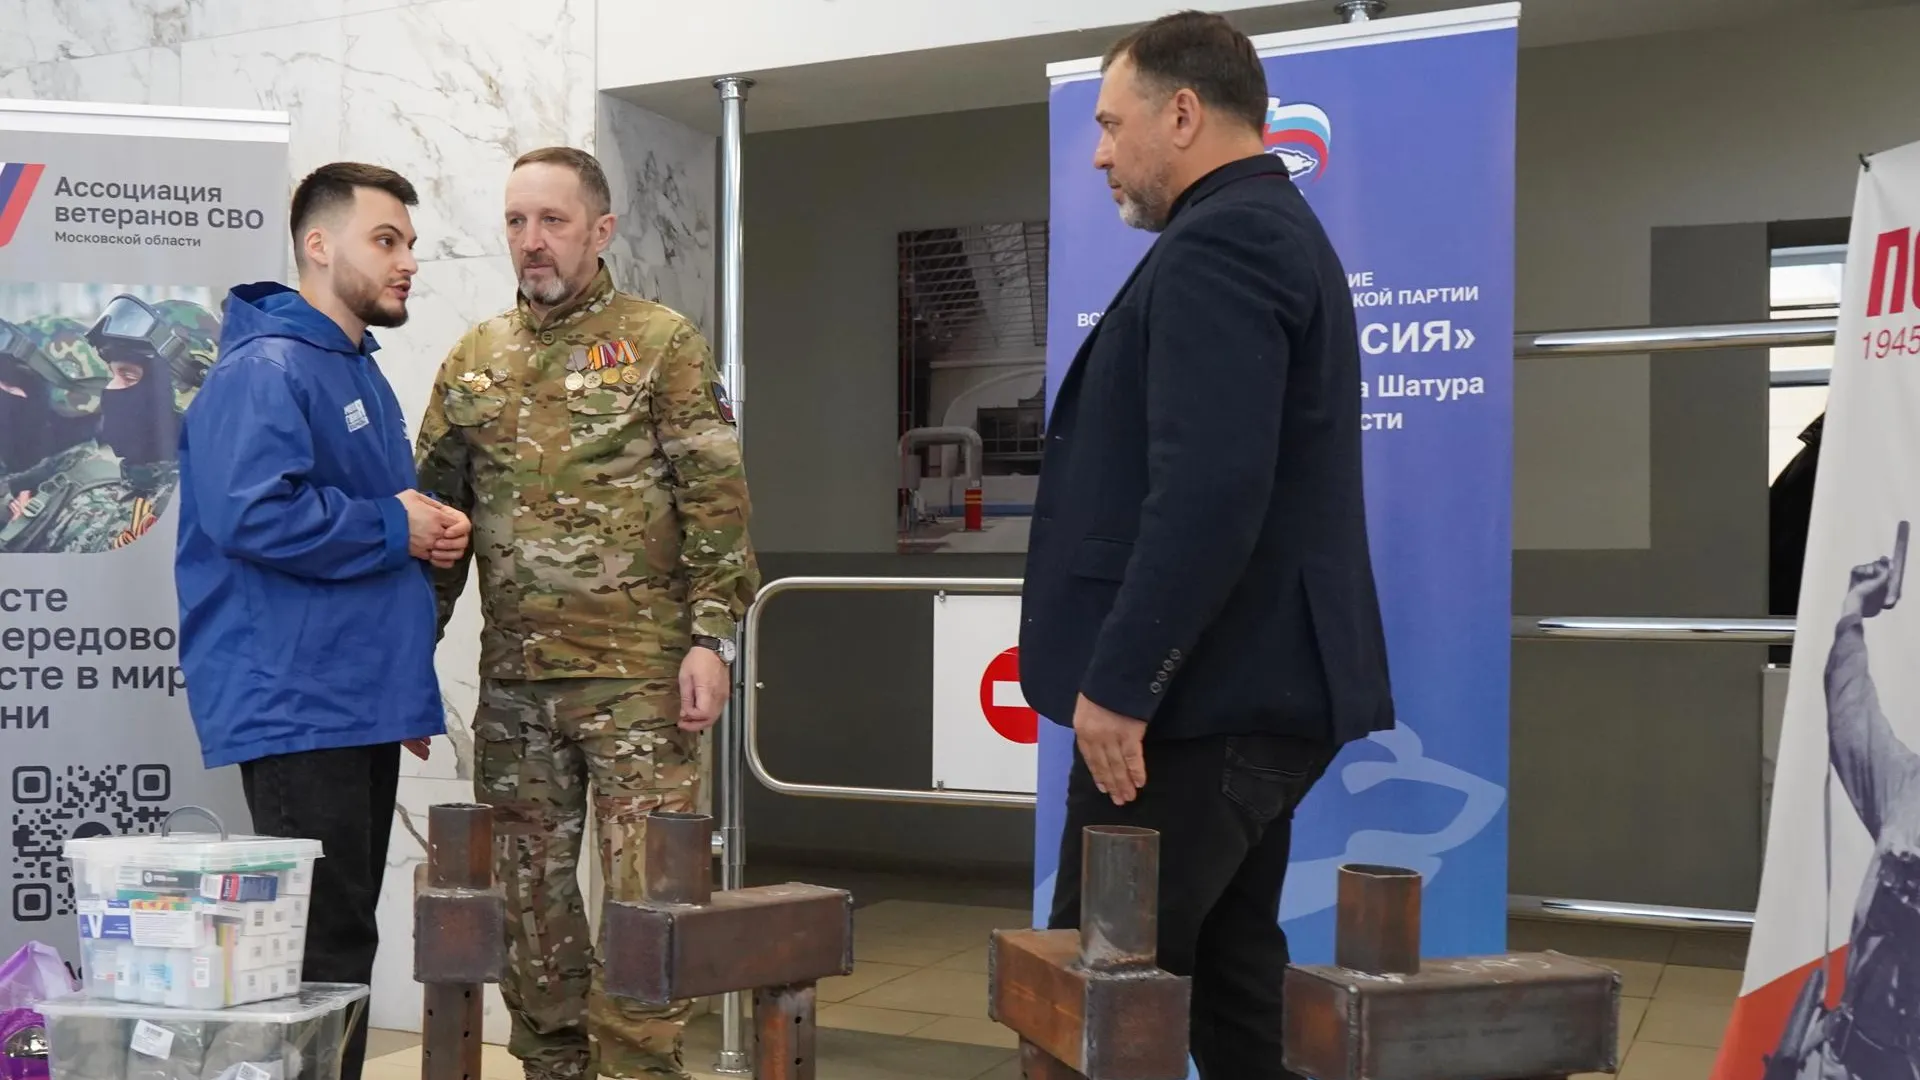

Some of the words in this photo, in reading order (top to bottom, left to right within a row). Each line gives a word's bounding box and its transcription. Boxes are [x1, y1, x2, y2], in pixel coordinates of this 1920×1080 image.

[54, 176, 222, 203] Ассоциация
[55, 206, 199, 229] ветеранов
[207, 208, 264, 230] СВО
[55, 231, 141, 246] Московской
[144, 234, 201, 247] области
[1398, 286, 1479, 305] ПАРТИИ
[1378, 374, 1485, 402] Шатура
[77, 666, 98, 689] в
